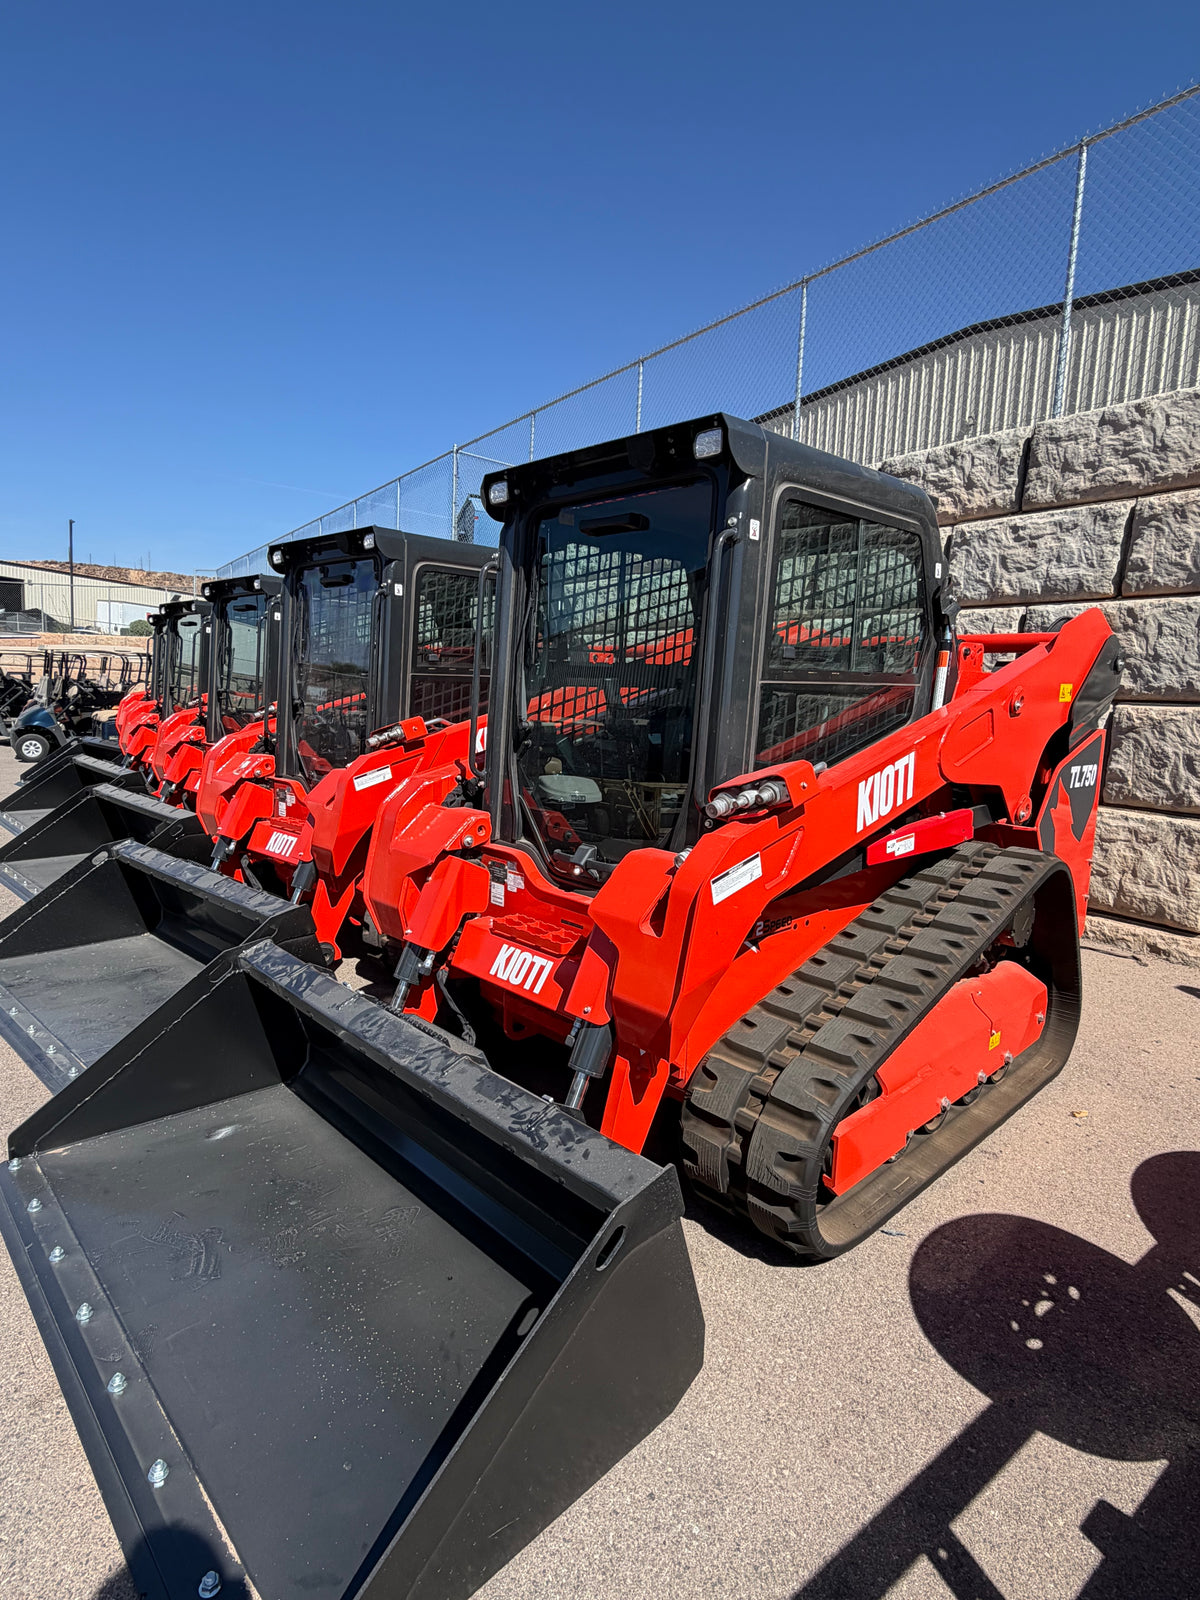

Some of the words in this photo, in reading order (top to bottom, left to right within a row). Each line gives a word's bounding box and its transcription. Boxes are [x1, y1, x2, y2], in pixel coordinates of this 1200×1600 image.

[857, 751, 916, 833] KIOTI
[1069, 763, 1098, 789] TL750
[265, 831, 298, 858] KIOTI
[489, 943, 554, 995] KIOTI
